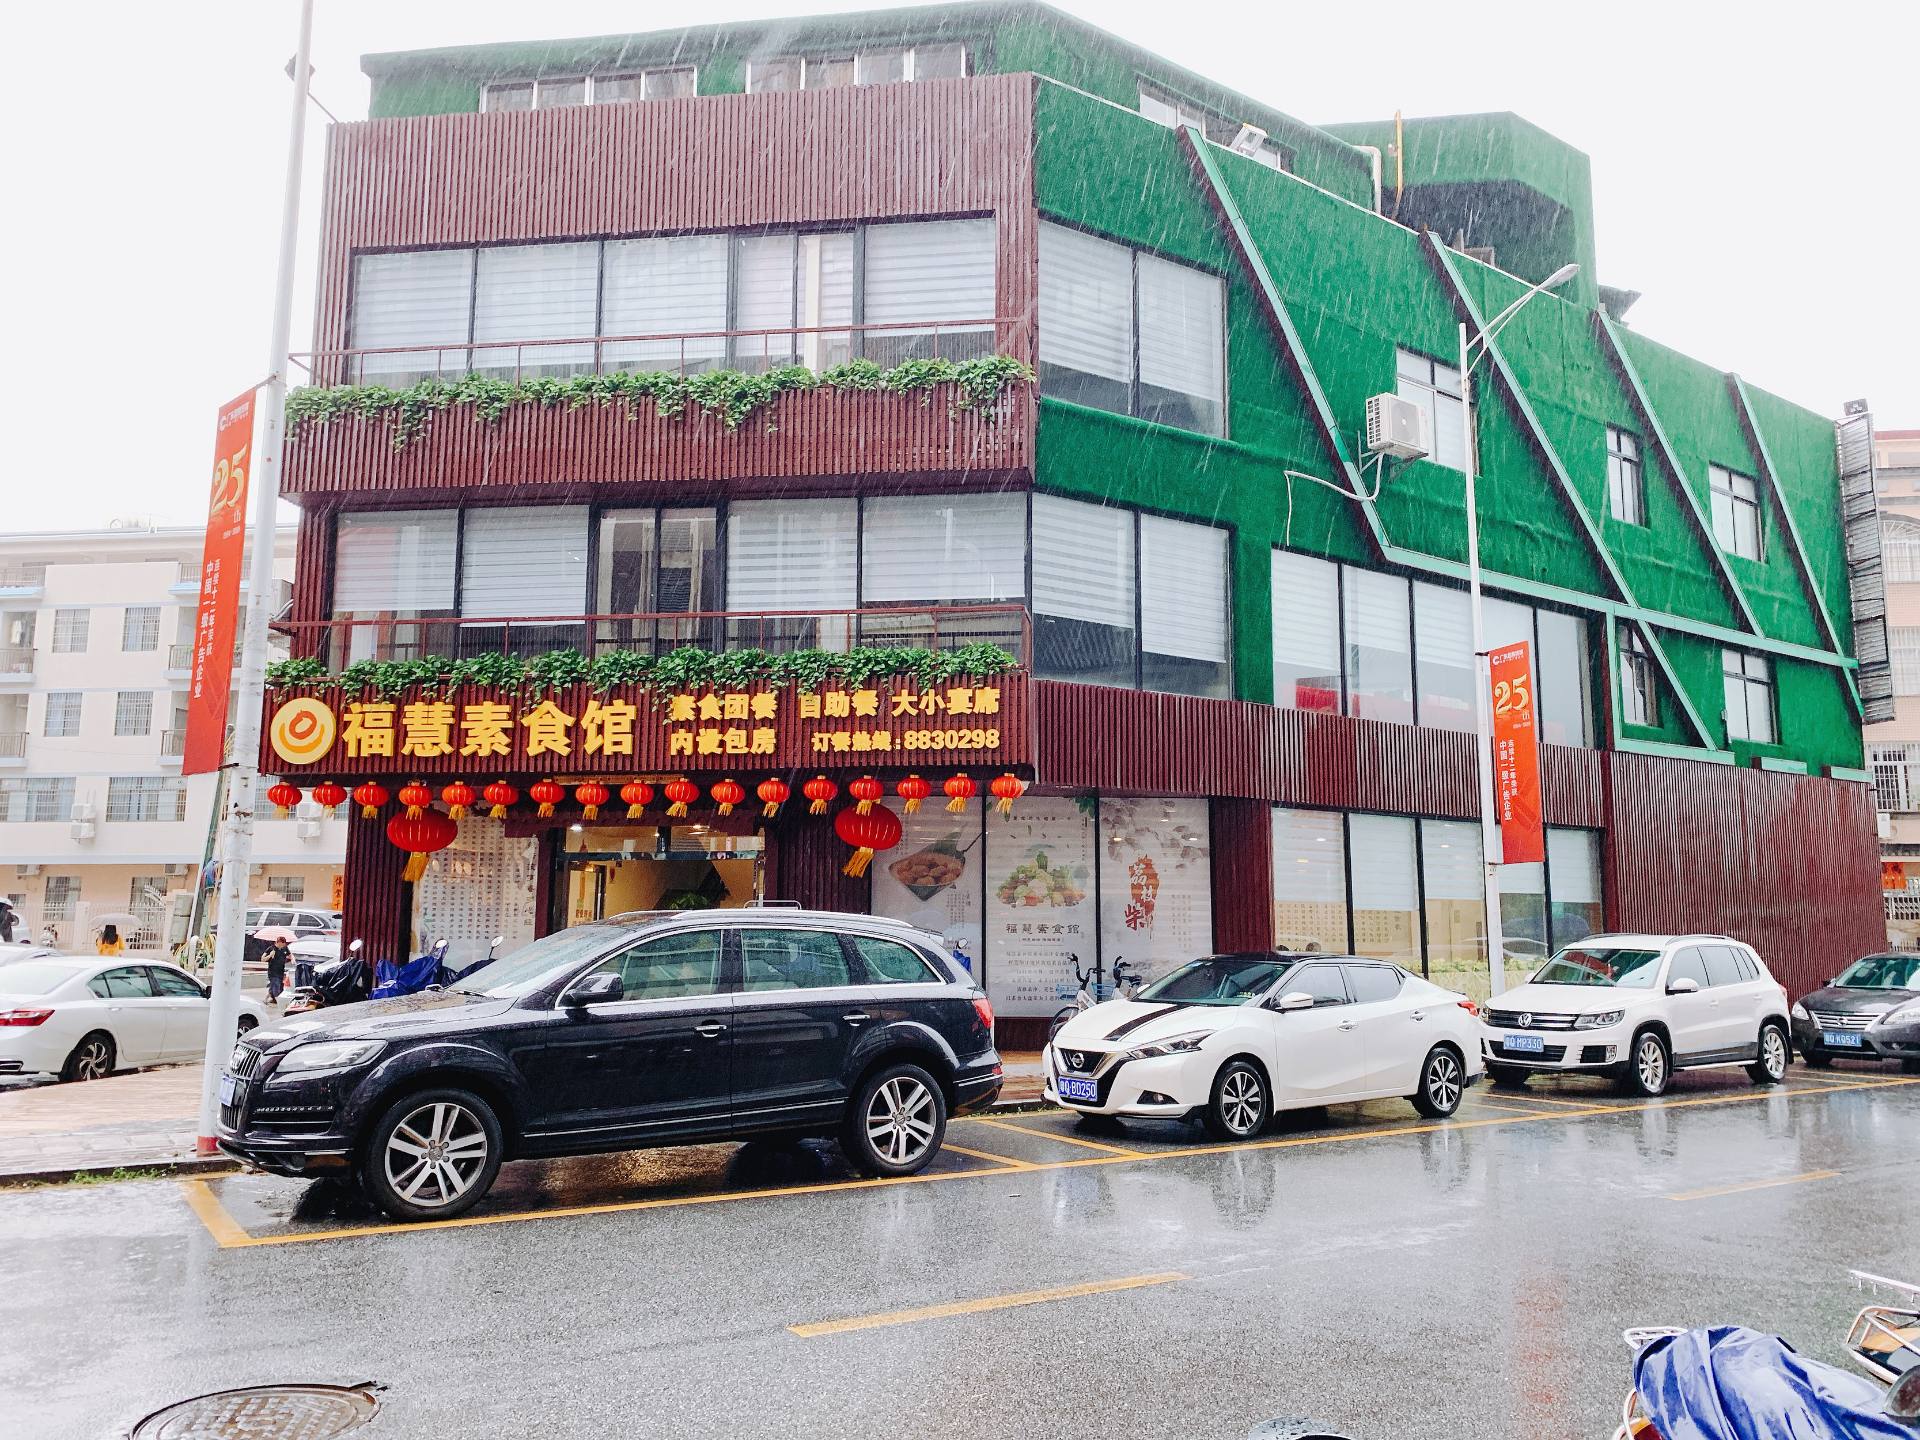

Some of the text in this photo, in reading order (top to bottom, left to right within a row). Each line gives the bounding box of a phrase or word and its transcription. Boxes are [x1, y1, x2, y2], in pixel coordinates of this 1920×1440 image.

[212, 443, 247, 513] 25
[193, 560, 213, 699] 中国一级广告企业
[669, 691, 778, 721] 素食团餐
[799, 689, 880, 719] 自助餐
[891, 686, 1000, 717] 大小宴席
[1495, 673, 1529, 714] 25
[342, 699, 637, 758] 福慧素食馆
[1500, 740, 1513, 821] 中国一级广告企业
